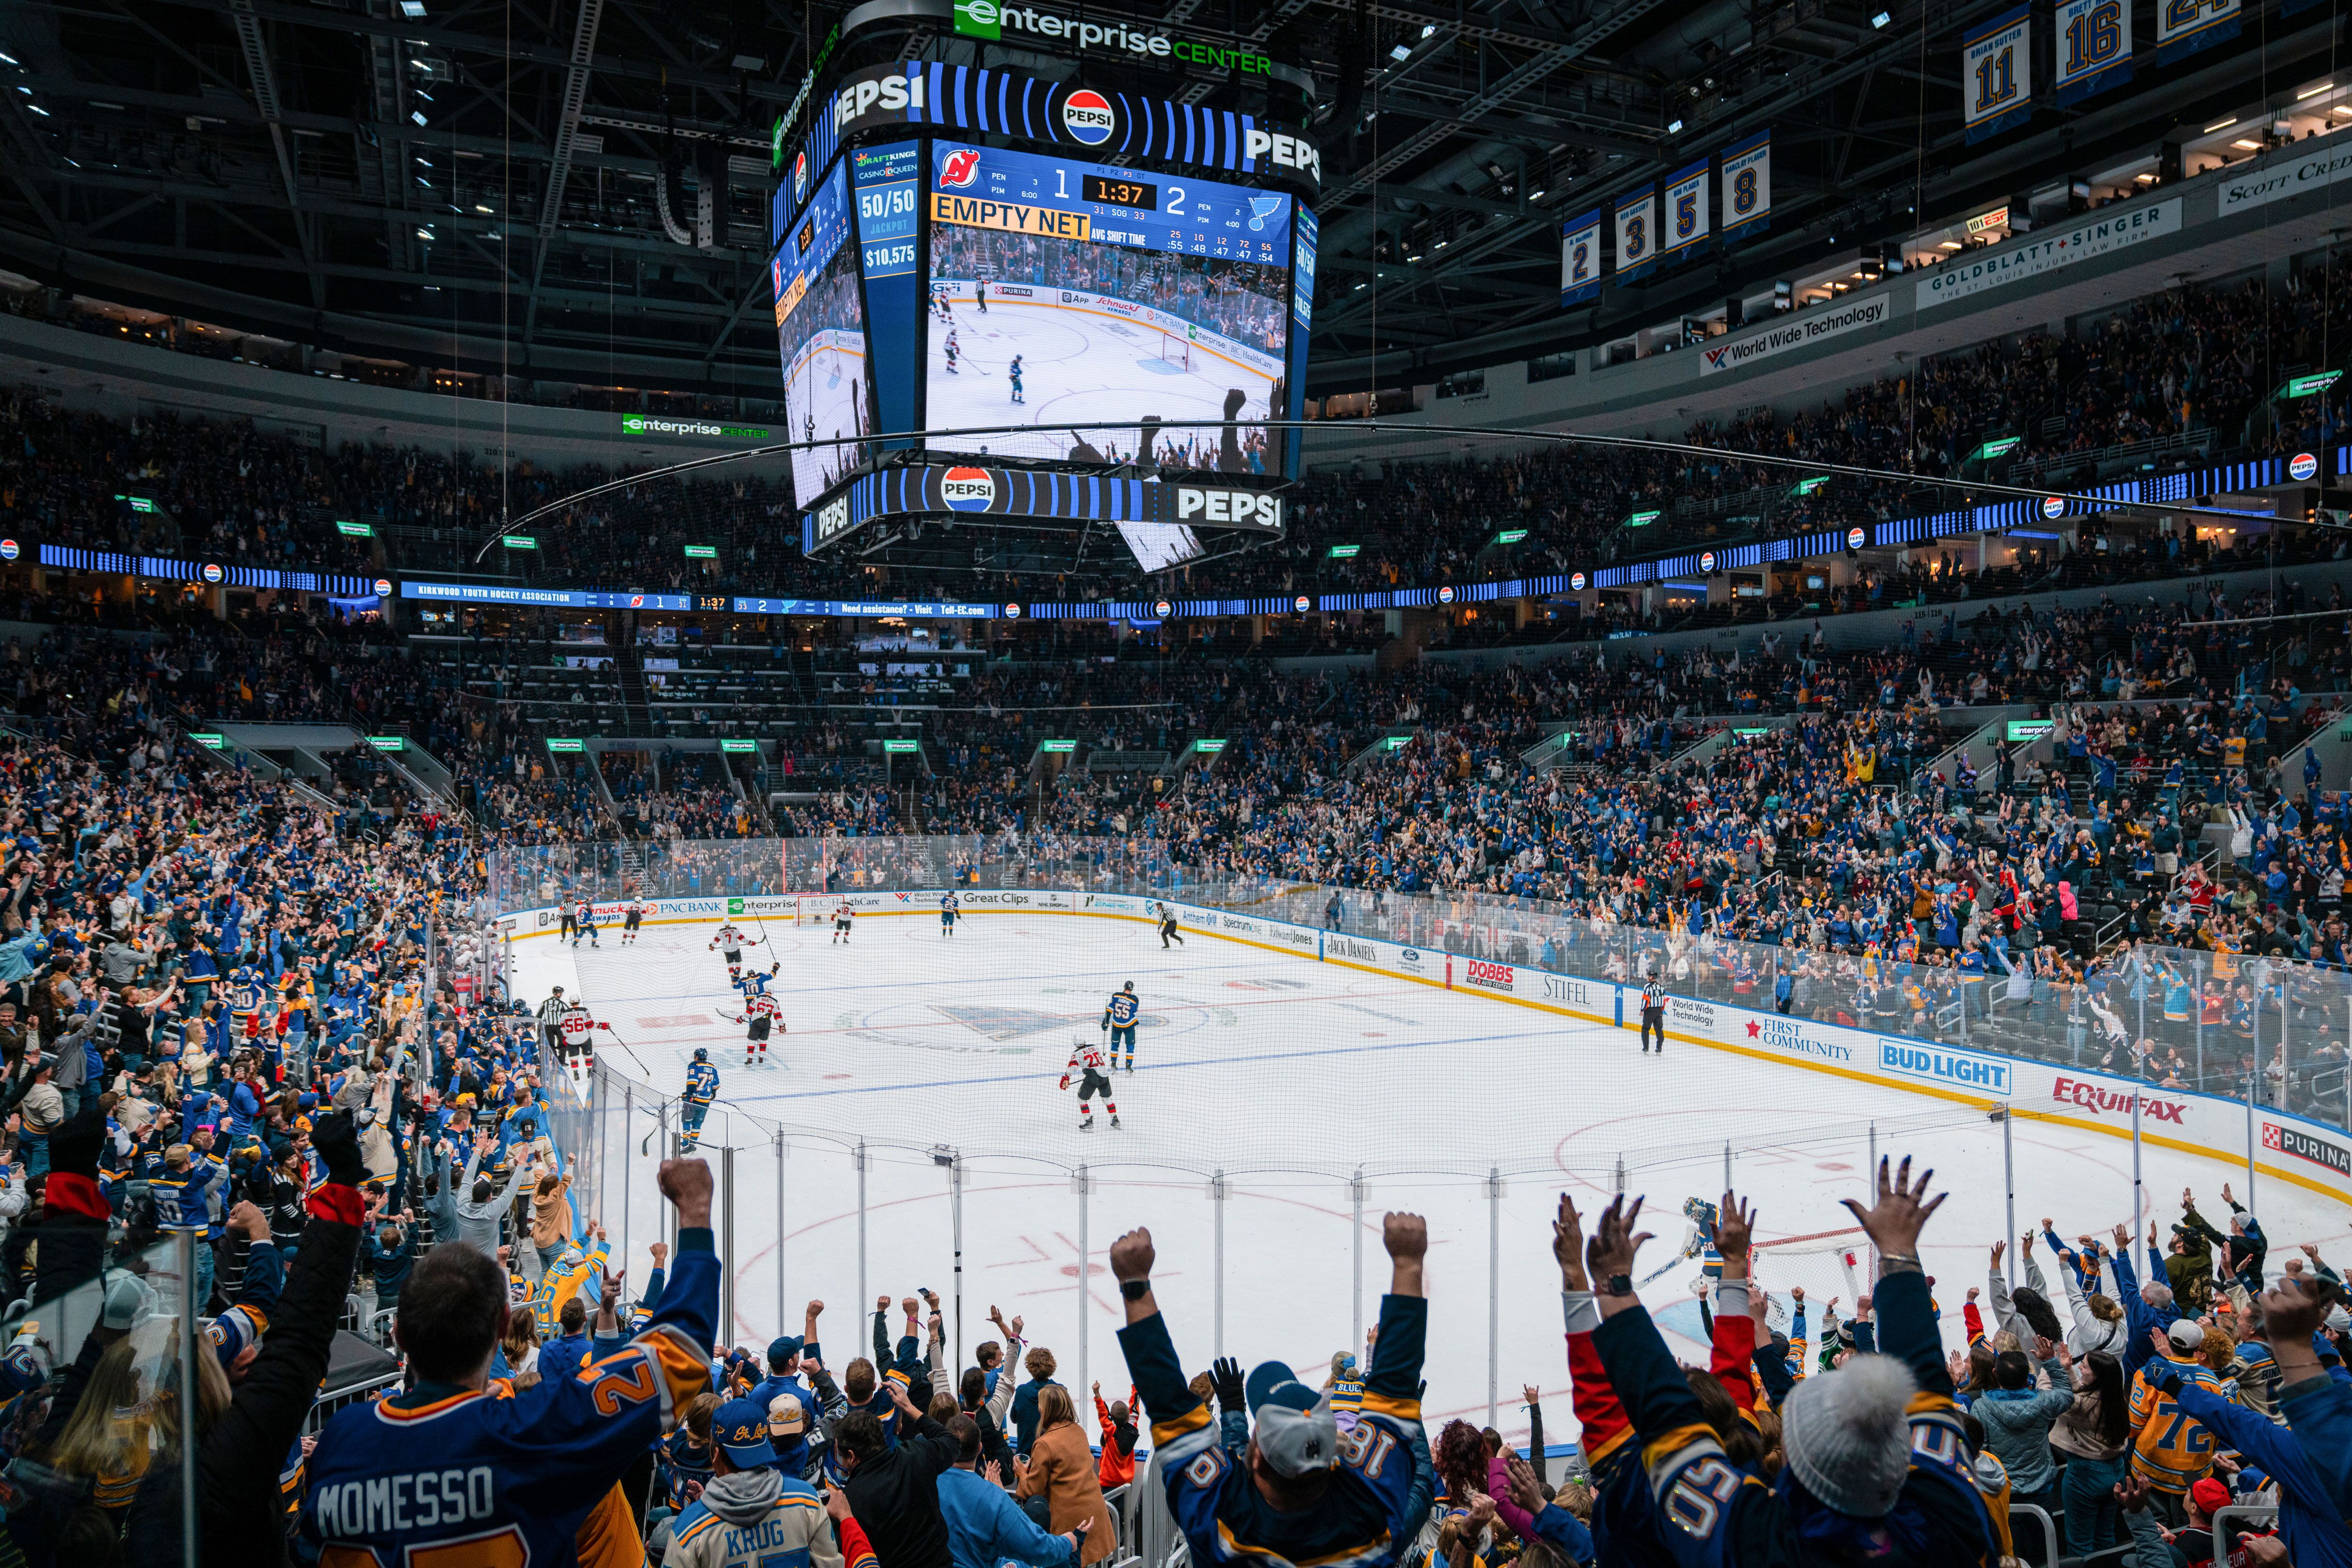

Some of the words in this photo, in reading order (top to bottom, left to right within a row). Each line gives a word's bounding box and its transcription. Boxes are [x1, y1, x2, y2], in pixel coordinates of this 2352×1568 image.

[954, 0, 1171, 56] enterprise
[1174, 42, 1271, 75] CENTER
[1971, 43, 1993, 59] BRIAN
[1995, 28, 2022, 48] SUTTER
[2066, 1, 2121, 75] 16
[1977, 46, 2017, 112] 11
[773, 69, 813, 150] enterprise
[834, 75, 923, 135] PEPSI
[1067, 108, 1111, 126] PEPSI
[858, 151, 916, 166] DRAFTKINGS
[1246, 129, 1320, 185] PEPS
[859, 169, 885, 179] CASINO
[894, 164, 917, 174] QUEEN
[992, 173, 1006, 181] PEN
[1055, 169, 1069, 199] 1
[1098, 181, 1143, 204] 1:37
[1734, 167, 1756, 215] 8
[2227, 175, 2290, 204] SCOTT
[862, 189, 914, 218] 50/50
[1094, 206, 1104, 215] 31
[1112, 208, 1127, 217] SOG
[1134, 211, 1144, 220] 33
[1167, 187, 1185, 216] 2
[815, 206, 822, 234] 2
[871, 219, 907, 234] JACKPOT
[938, 196, 1030, 229] EMPTY
[1039, 210, 1087, 237] NET
[1677, 192, 1696, 238] 5
[1969, 220, 1984, 231] 101
[1091, 228, 1106, 241] AVG
[1107, 231, 1127, 244] SHIFT
[1128, 233, 1146, 246] TIME
[1626, 216, 1645, 259] 3
[792, 241, 798, 266] 1
[866, 245, 914, 268] $10,575
[1191, 245, 1206, 253] :48
[1214, 247, 1229, 257] :47
[1236, 251, 1251, 259] :47
[1258, 254, 1273, 263] :54
[1297, 244, 1314, 277] 50/50
[1932, 241, 2053, 290] GOLDBLATT
[2073, 208, 2160, 246] SINGER
[1573, 242, 1588, 282] 2
[1941, 289, 1960, 300] THE
[1990, 270, 2022, 285] LOUIS
[2031, 253, 2075, 272] INJURY
[2084, 242, 2108, 256] LAW
[2118, 230, 2148, 246] FIRM
[777, 290, 795, 323] EMPTY
[795, 271, 805, 300] NET
[1096, 297, 1141, 312] Schnucks
[1107, 307, 1131, 316] REWARDS
[1189, 329, 1225, 349] enterprise
[1732, 338, 1765, 360] World
[1770, 329, 1801, 348] Wide
[1804, 303, 1883, 337] Technology
[1243, 351, 1272, 369] HealthCare
[623, 419, 721, 435] enterprise
[722, 427, 768, 439] CENTER
[945, 484, 991, 496] PEPSI
[819, 496, 847, 539] PEPSI
[1178, 488, 1280, 527] PEPSI
[418, 586, 460, 596] KIRKWOOD
[462, 589, 487, 598] YOUTH
[491, 590, 518, 599] HOCKEY
[522, 592, 569, 602] ASSOCIATION
[657, 597, 664, 608] 1
[701, 597, 725, 606] 1:37
[759, 600, 767, 611] 2
[842, 603, 860, 613] Need
[863, 605, 907, 614] assistance?
[915, 605, 932, 614] Visit
[965, 893, 998, 903] Great
[1002, 892, 1028, 905] Clips
[1183, 911, 1205, 924] Anthem
[1224, 917, 1250, 931] Spectrum
[725, 934, 731, 944] 7
[1328, 939, 1345, 954] JACK
[1405, 951, 1417, 960] Ford
[1468, 960, 1513, 983] DOBBS
[1544, 974, 1590, 1004] STIFEL
[1114, 1003, 1131, 1019] 55
[1672, 999, 1693, 1011] World
[1694, 1003, 1714, 1015] Wide
[1673, 1008, 1713, 1027] Technology
[564, 1018, 584, 1033] 56
[1764, 1019, 1801, 1036] FIRST
[1764, 1032, 1852, 1060] COMMUNITY
[1084, 1052, 1105, 1068] 20
[1883, 1045, 1931, 1072] BUD
[1934, 1055, 2006, 1087] LIGHT
[2053, 1077, 2187, 1125] EQUIFAX
[2285, 1132, 2348, 1170] PURINA
[1644, 1260, 1676, 1283] TRUE
[2157, 1403, 2212, 1454] 72
[318, 1466, 493, 1538] MOMESSO
[724, 1520, 784, 1558] KRUG
